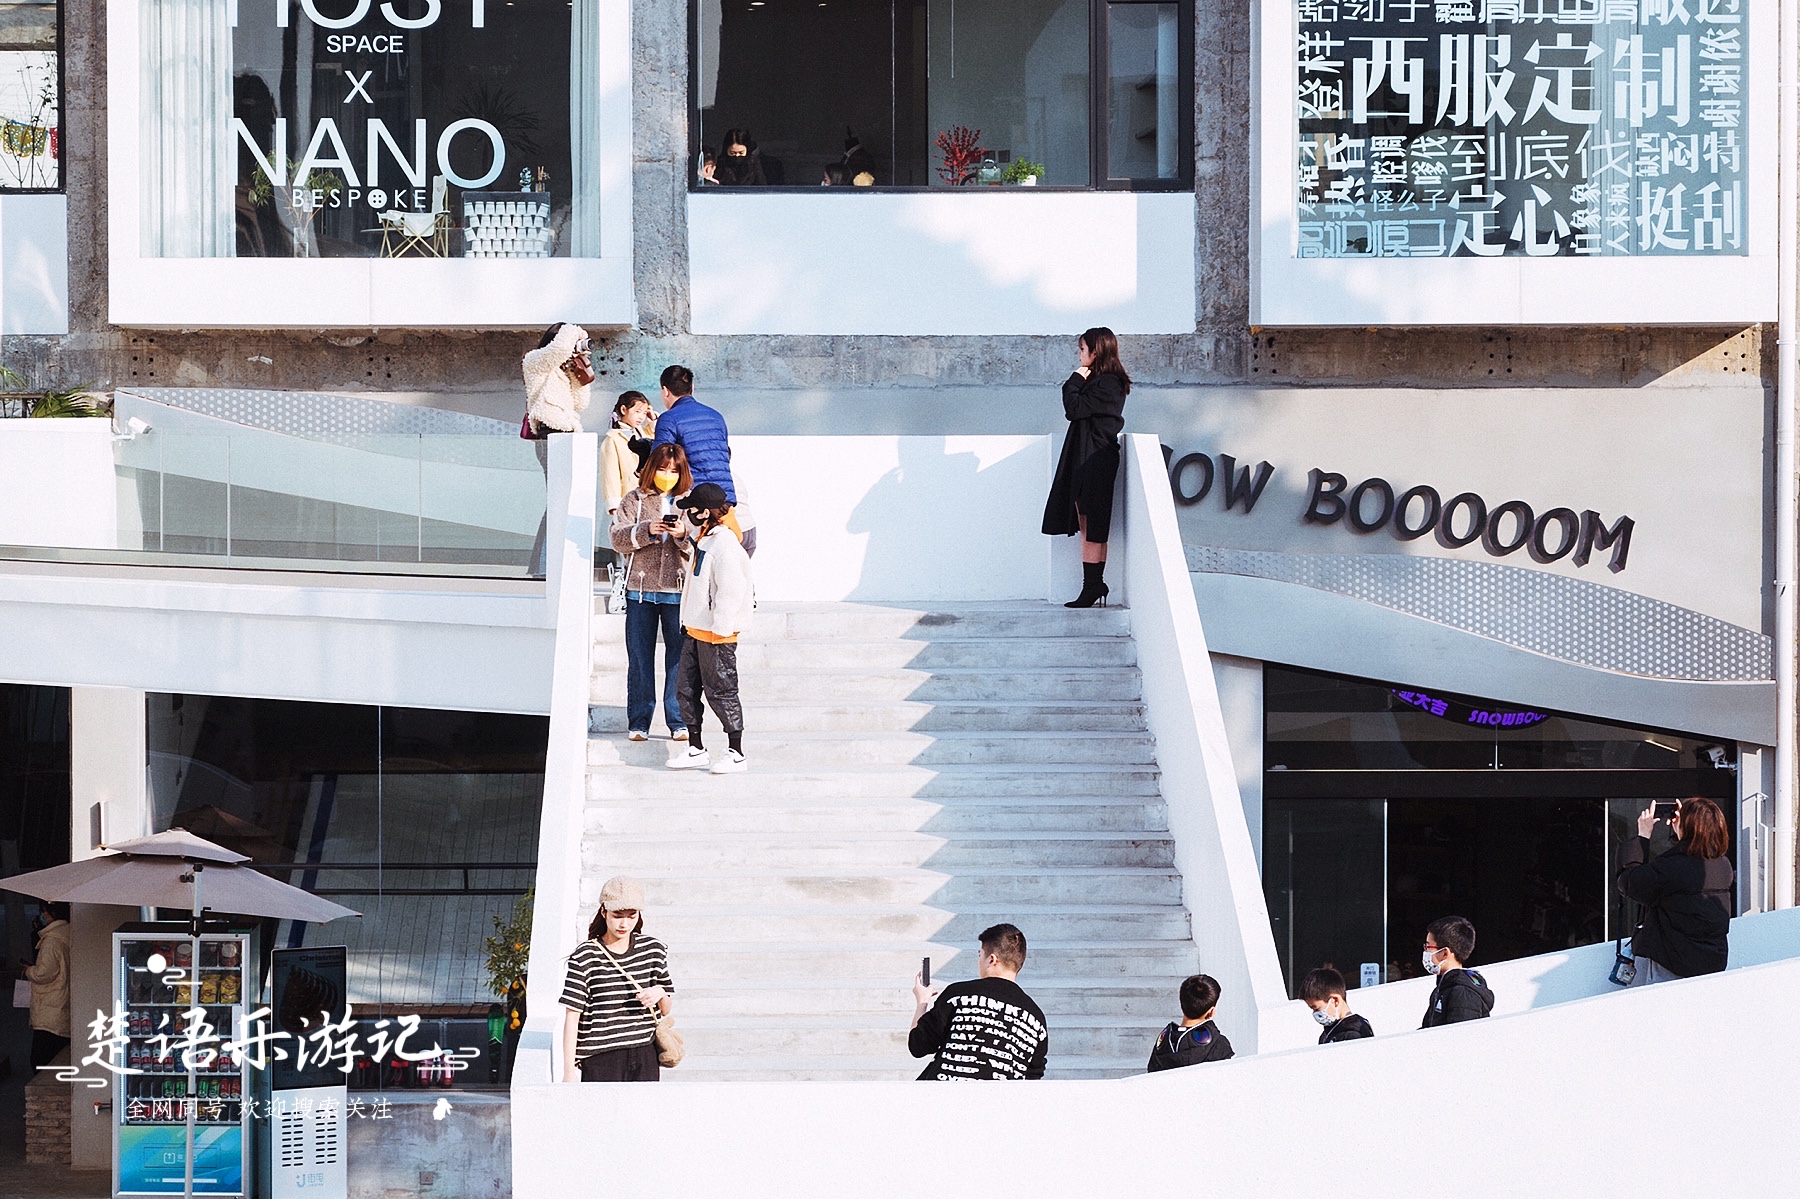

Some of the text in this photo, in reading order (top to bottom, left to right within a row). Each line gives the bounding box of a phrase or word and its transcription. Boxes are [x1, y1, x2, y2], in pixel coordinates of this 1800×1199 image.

[326, 35, 404, 53] SPACE
[1348, 33, 1691, 127] 西服定制
[228, 117, 506, 188] NANO
[1323, 132, 1366, 219] 热昏
[1371, 135, 1408, 184] 腔调
[1661, 130, 1741, 175] 闷特
[1448, 184, 1572, 257] 定心
[1605, 182, 1631, 255] 人来疯
[1636, 180, 1741, 251] 挺刮
[1160, 444, 1635, 574] OW BOOOOOM
